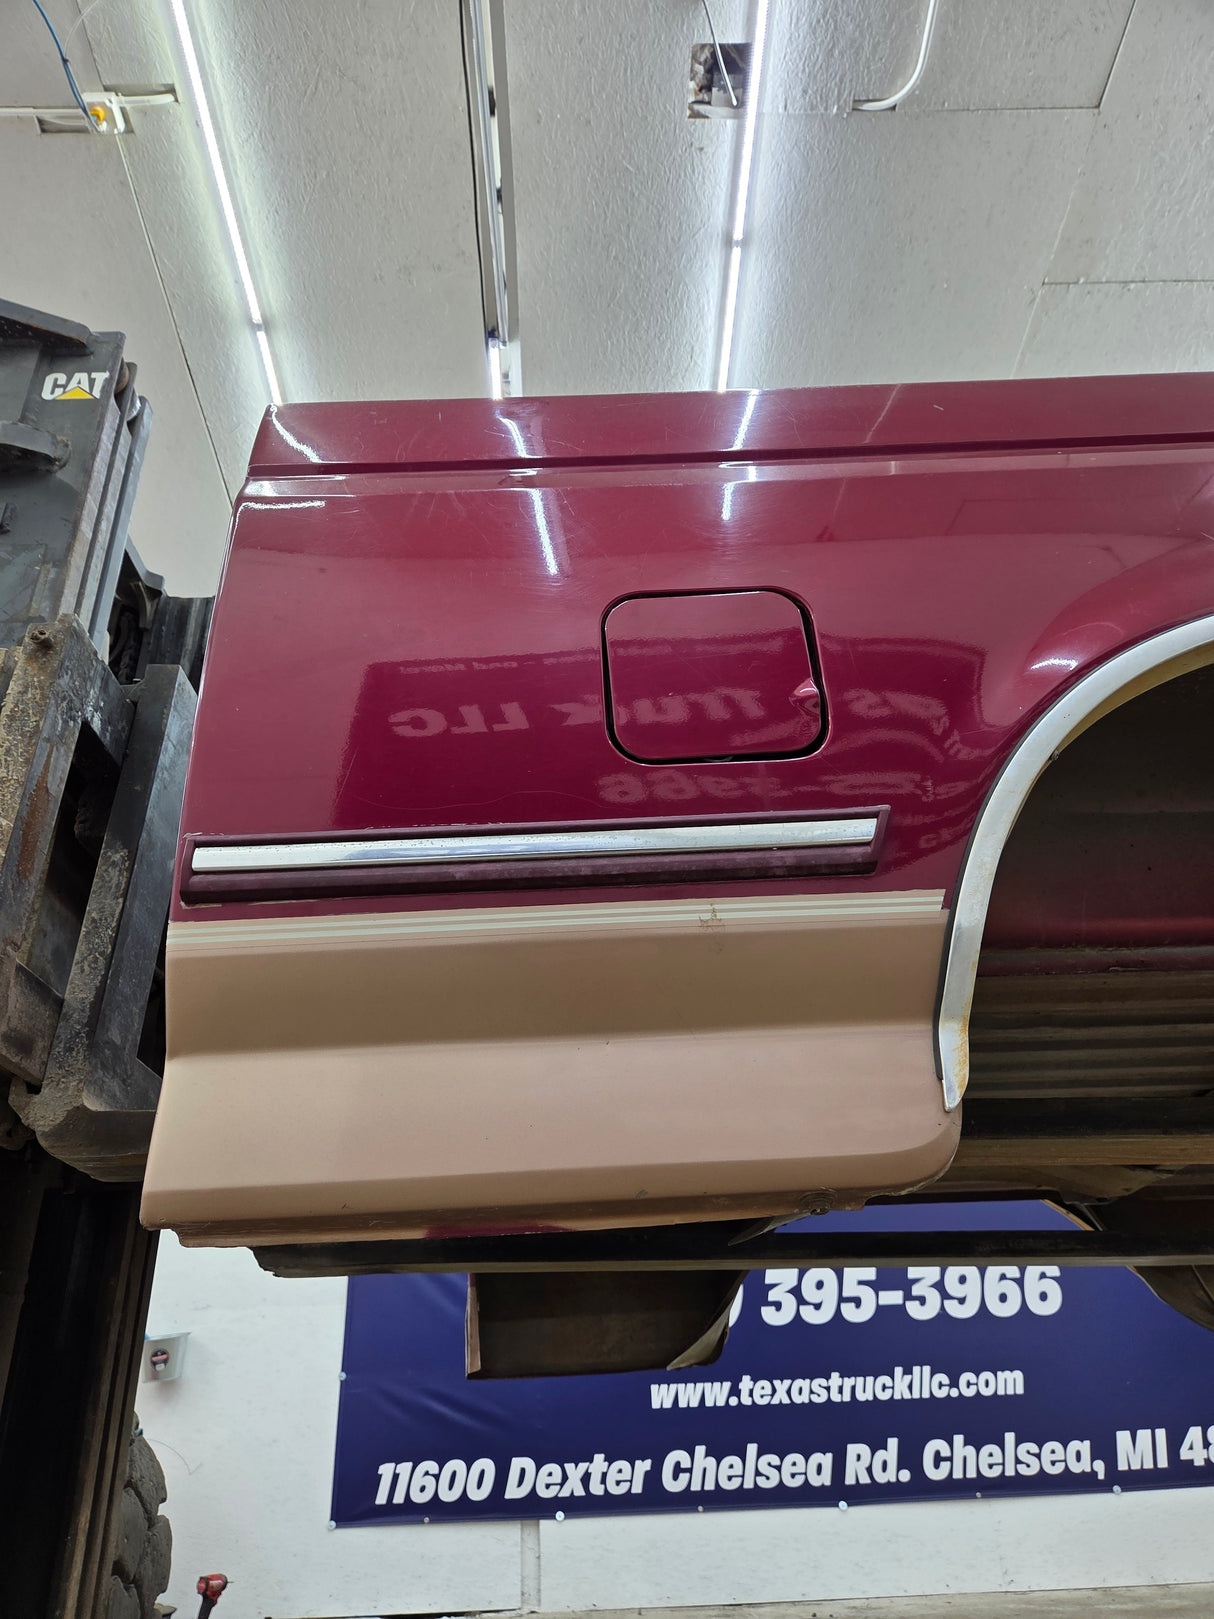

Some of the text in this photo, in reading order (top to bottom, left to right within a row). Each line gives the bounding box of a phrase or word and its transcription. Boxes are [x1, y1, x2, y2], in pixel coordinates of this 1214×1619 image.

[41, 370, 110, 400] CAT
[760, 1265, 1063, 1327] 395-3966
[650, 1365, 1025, 1409] www.texastruckllc.com
[374, 1458, 496, 1505] 11600
[504, 1453, 651, 1500] Dexter
[661, 1443, 833, 1493] Chelsea
[844, 1437, 911, 1485] Rd.
[922, 1432, 1105, 1480] Chelsea,
[1115, 1427, 1169, 1471] MI
